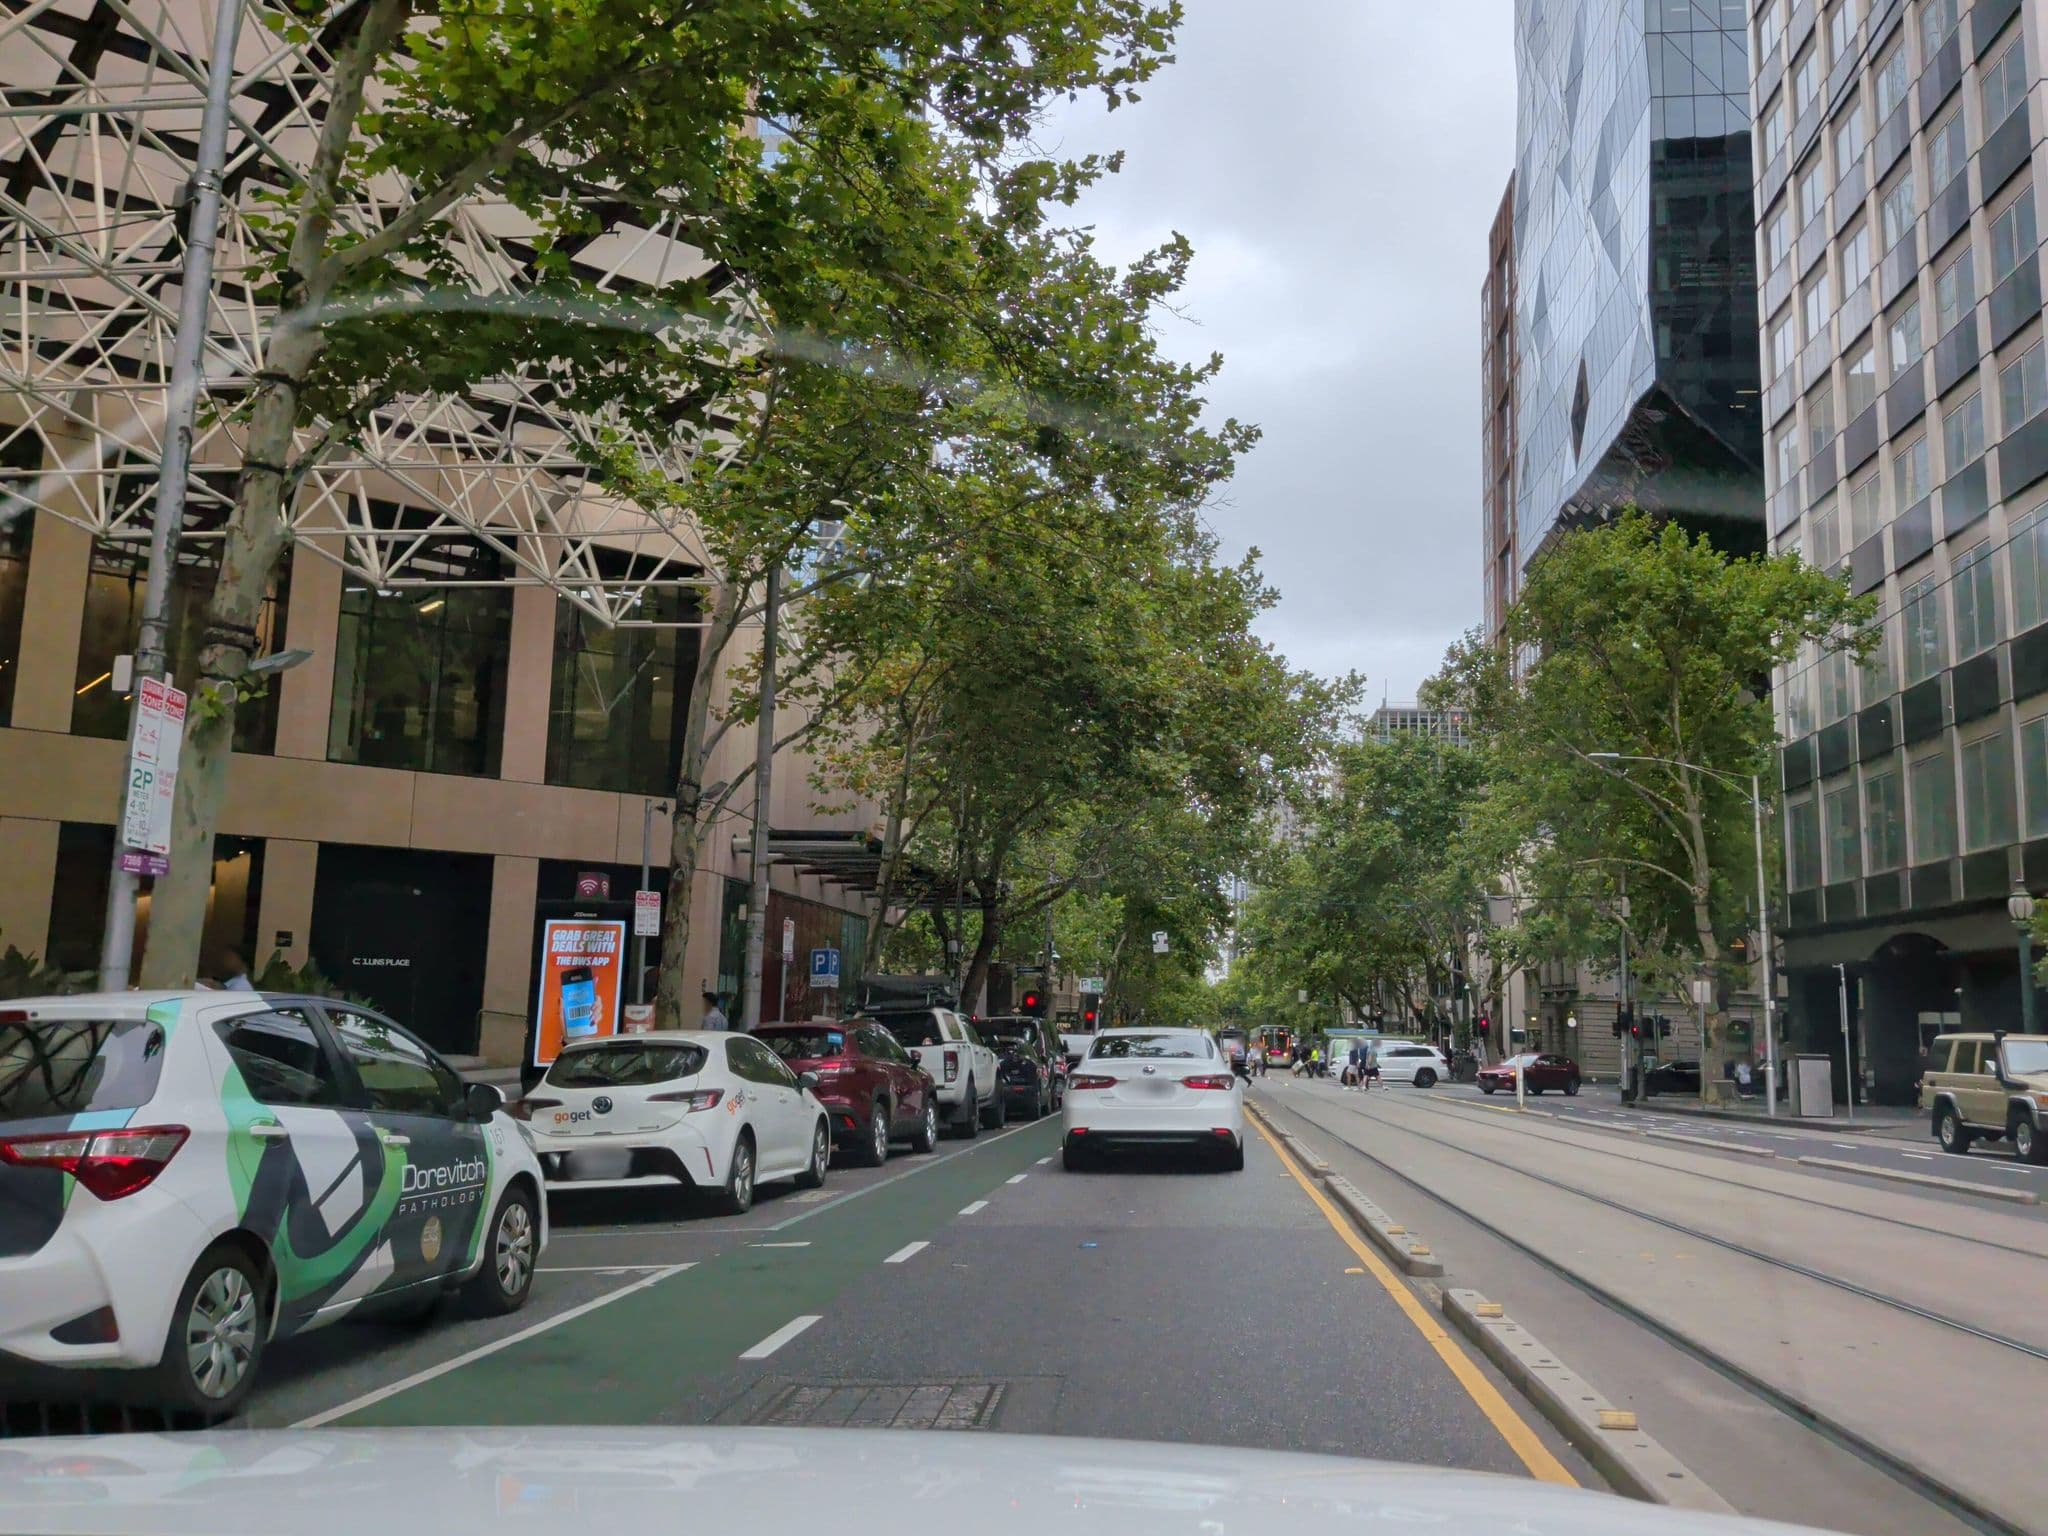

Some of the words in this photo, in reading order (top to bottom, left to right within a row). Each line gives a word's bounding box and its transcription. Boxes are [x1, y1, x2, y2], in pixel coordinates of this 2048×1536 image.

[141, 693, 163, 711] ZONE
[164, 702, 184, 719] ZONE
[132, 768, 153, 790] 2P
[553, 930, 581, 941] GRAB
[582, 930, 616, 942] GREAT
[552, 941, 584, 952] DEALS
[586, 942, 615, 953] WITH
[386, 958, 410, 967] PLACE
[556, 956, 571, 966] THE
[592, 956, 610, 966] APP
[815, 954, 825, 971] P
[831, 954, 838, 971] P
[401, 1155, 485, 1192] Dorevitch
[399, 1189, 484, 1216] PATHOLOGY
